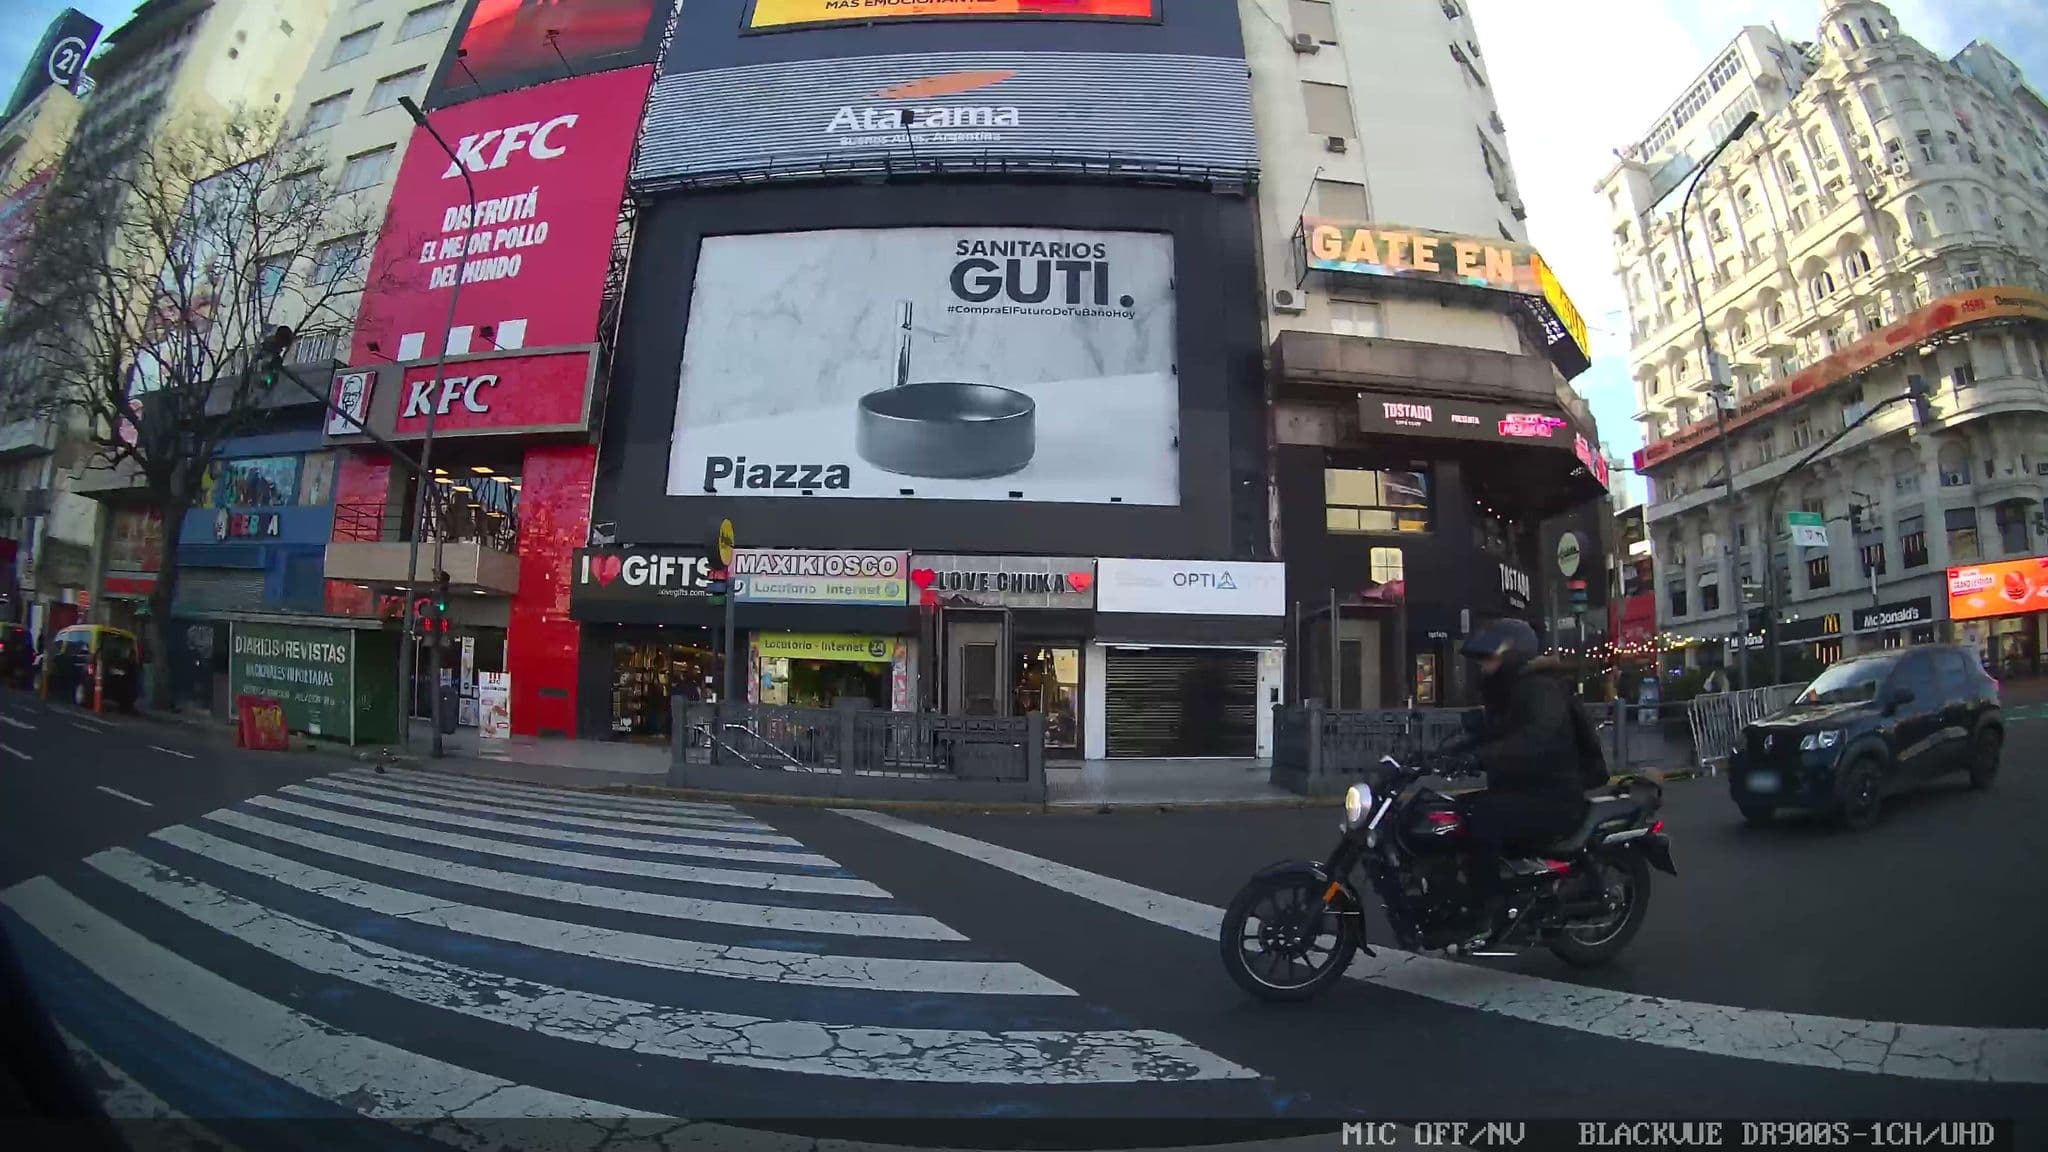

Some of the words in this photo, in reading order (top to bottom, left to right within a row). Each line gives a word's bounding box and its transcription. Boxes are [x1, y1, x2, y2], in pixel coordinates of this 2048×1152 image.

[56, 48, 81, 75] 21
[441, 114, 580, 180] KFC
[441, 186, 540, 233] DISFRUTÁ
[419, 241, 438, 264] EL
[493, 221, 549, 252] POLLO
[955, 239, 1106, 259] SANITARIOS
[1312, 225, 1440, 273] GATE
[429, 265, 458, 290] DEL
[460, 254, 522, 285] MUNDO
[949, 257, 1134, 308] GUTI.
[402, 374, 498, 418] KFC
[1382, 402, 1433, 423] TOSTADO
[704, 456, 850, 490] Piazza
[580, 555, 590, 584] I
[622, 554, 713, 587] GiFTS
[735, 553, 899, 577] MAXIKIOSCO
[826, 583, 880, 595] Internet
[938, 570, 990, 592] LOVE
[996, 572, 1066, 594] CHUKA
[1863, 606, 1920, 629] McDonald's
[235, 636, 281, 657] DIARIOS
[285, 640, 346, 664] REVISTAS
[764, 640, 812, 650] Locutorio
[821, 641, 865, 652] Internet
